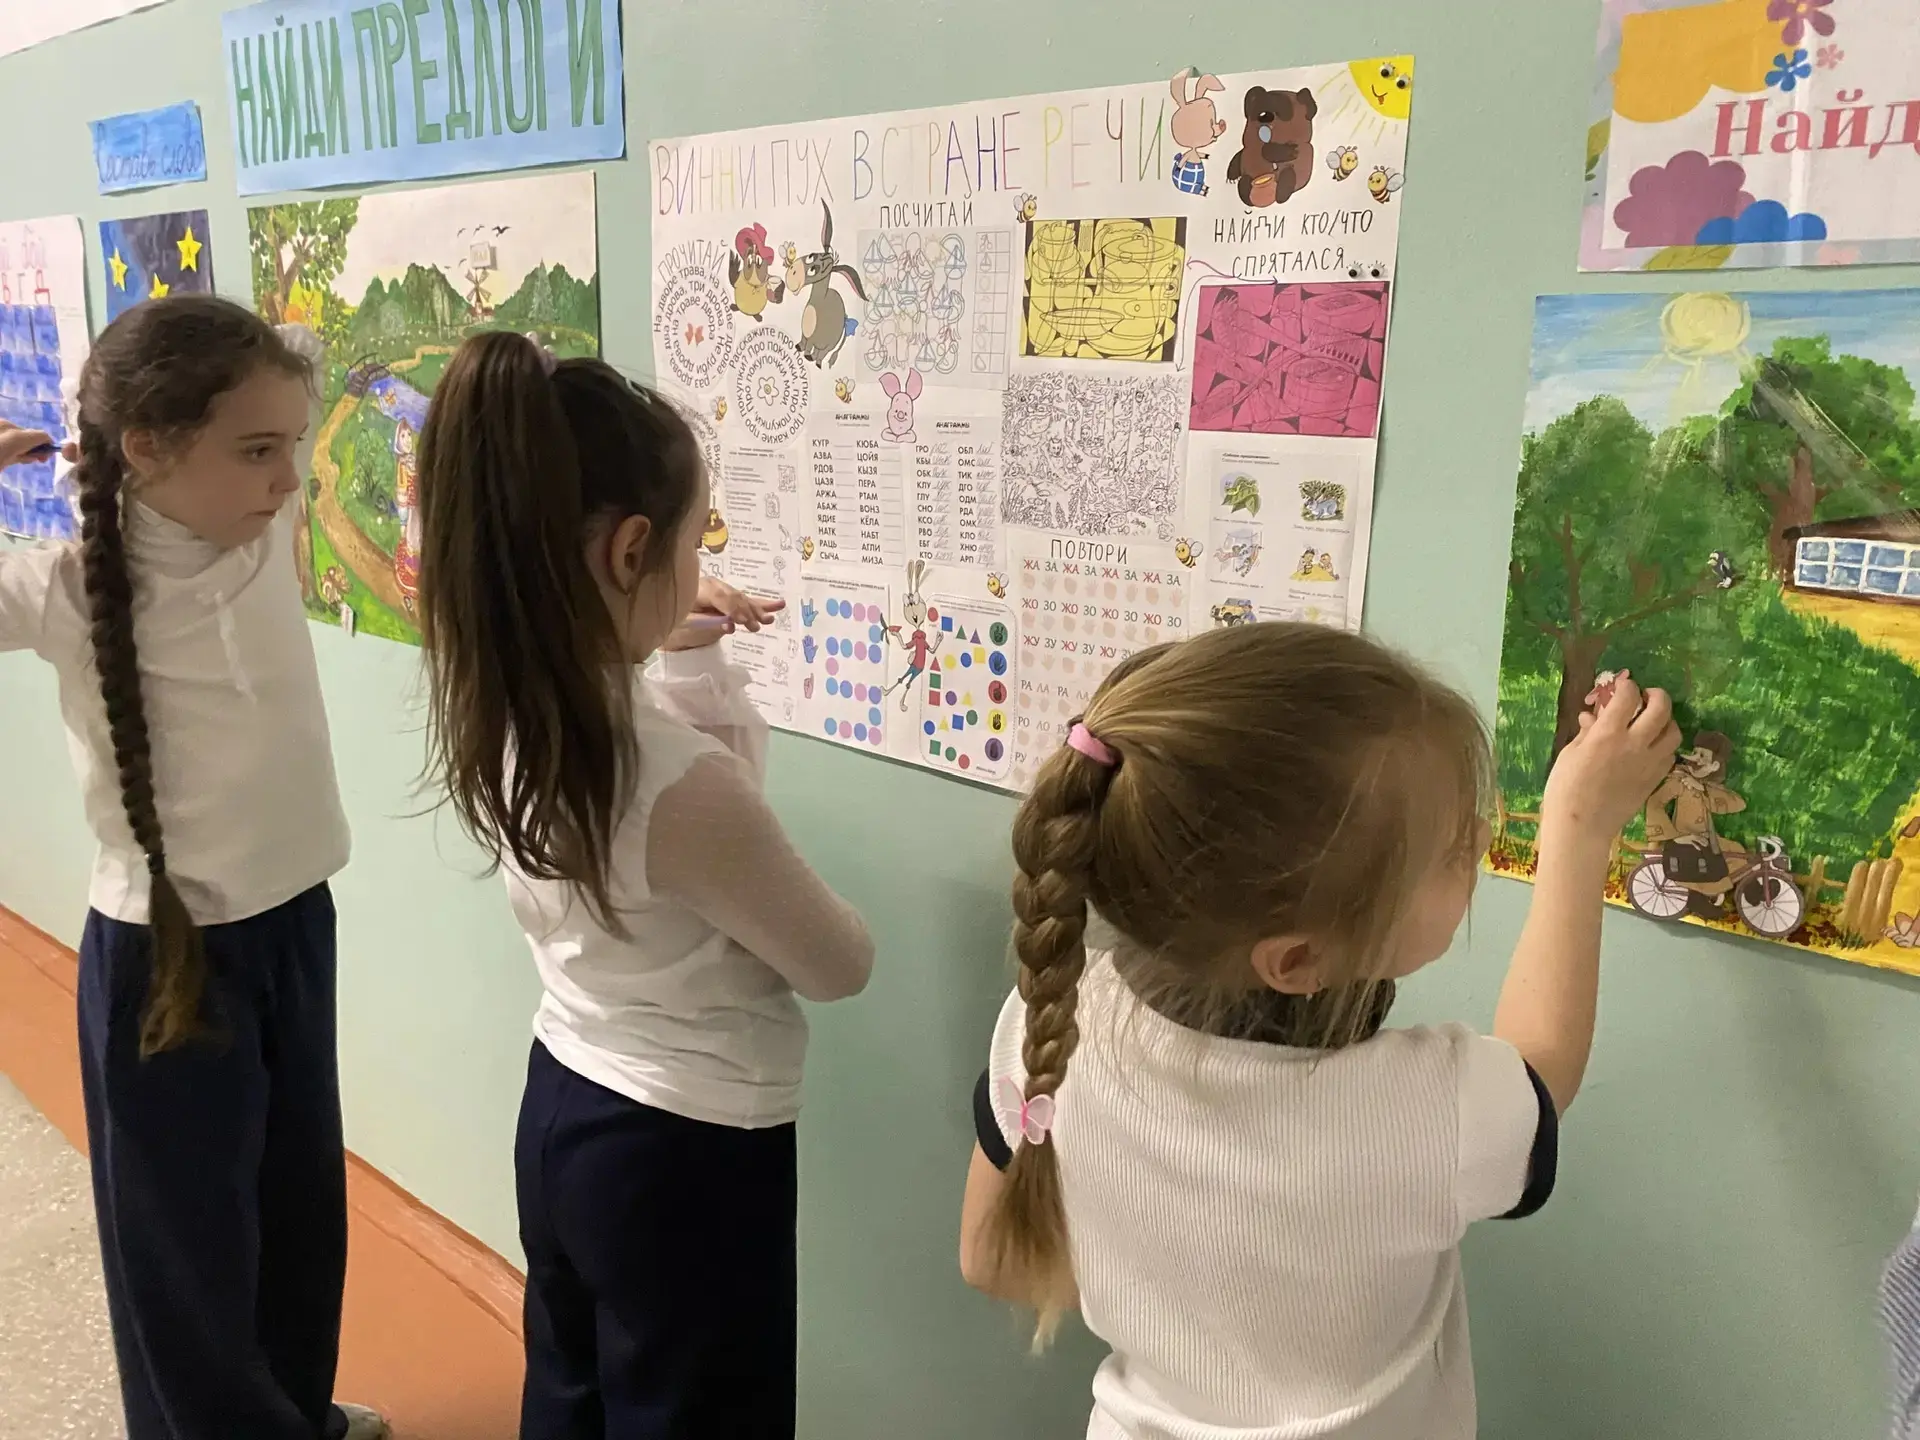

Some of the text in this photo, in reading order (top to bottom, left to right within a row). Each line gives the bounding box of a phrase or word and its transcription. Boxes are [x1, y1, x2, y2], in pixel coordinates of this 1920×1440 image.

[231, 15, 350, 168] НАЙДИ
[656, 97, 1164, 215] ВИННИ ПУХ В СТРАНЕ РЕЧИ
[879, 200, 974, 229] ПОСЧИТАЙ
[1214, 208, 1374, 243] НАЙДИ КТО/ЧТО
[658, 239, 728, 283] ПРОЧИТАЙ
[1231, 246, 1346, 278] СПРЯТАЛСЯ
[857, 440, 879, 448] КЮБА
[916, 445, 929, 453] ГРО
[958, 446, 973, 454] ОБЛ
[813, 452, 832, 460] АЗВА
[958, 459, 976, 467] ОМС
[814, 464, 833, 473] РДОВ
[917, 469, 931, 477] ОБК
[958, 471, 972, 479] ТИК
[859, 479, 876, 488] ПЕРА
[917, 481, 931, 489] КЛУ
[816, 490, 837, 498] АРЖА
[859, 492, 878, 501] РТАМ
[959, 496, 976, 504] ОДМ
[960, 519, 977, 527] ОМК
[960, 532, 975, 540] КЛО
[960, 544, 977, 552] ХНЮ
[1051, 538, 1128, 564] ПОВТОРИ
[919, 551, 933, 559] КТО
[960, 555, 974, 564] АРП
[862, 556, 883, 565] МИЗА
[1024, 559, 1181, 586] ЖА ЗА ЖА ЗА ЖА ЗА ЖА ЗА
[1022, 598, 1181, 627] ЖО ЗО ЖО ЗО ЖО ЗО ЖО ЗО
[1024, 635, 1040, 646] ЖУ
[1045, 638, 1056, 649] ЗУ
[1061, 640, 1078, 652] ЖУ
[1083, 643, 1095, 655] ЗУ
[1100, 646, 1117, 658] ЖУ
[1021, 680, 1032, 691] РА
[1058, 686, 1069, 697] РА
[1018, 717, 1030, 727] РО
[1015, 752, 1027, 763] РУ
